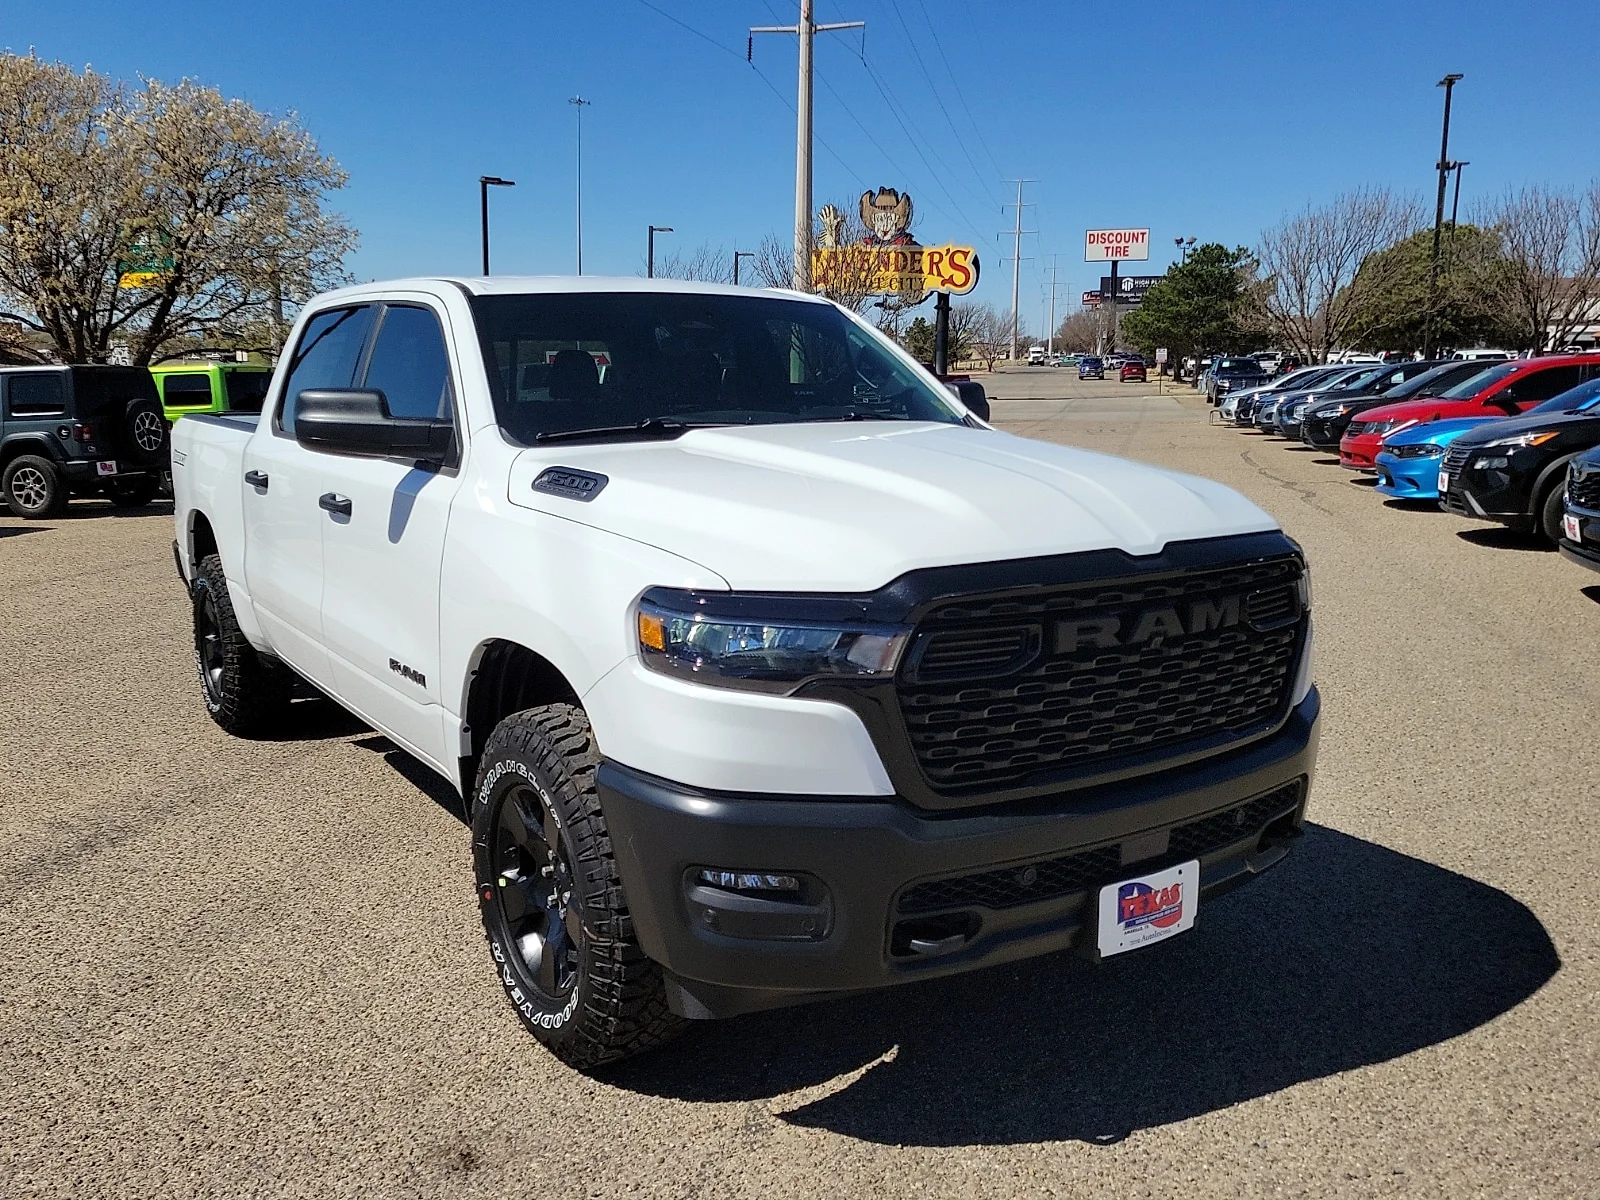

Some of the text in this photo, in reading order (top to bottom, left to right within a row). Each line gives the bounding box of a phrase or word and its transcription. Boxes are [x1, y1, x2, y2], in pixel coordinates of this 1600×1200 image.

[1088, 232, 1147, 244] DISCOUNT
[1104, 245, 1130, 258] TIRE
[888, 277, 929, 291] CITY
[1053, 595, 1240, 654] RAM
[389, 657, 427, 690] RAM
[478, 759, 562, 830] WRANGLER
[1121, 883, 1183, 920] TEXAS
[492, 941, 579, 1029] GOODYEAR
